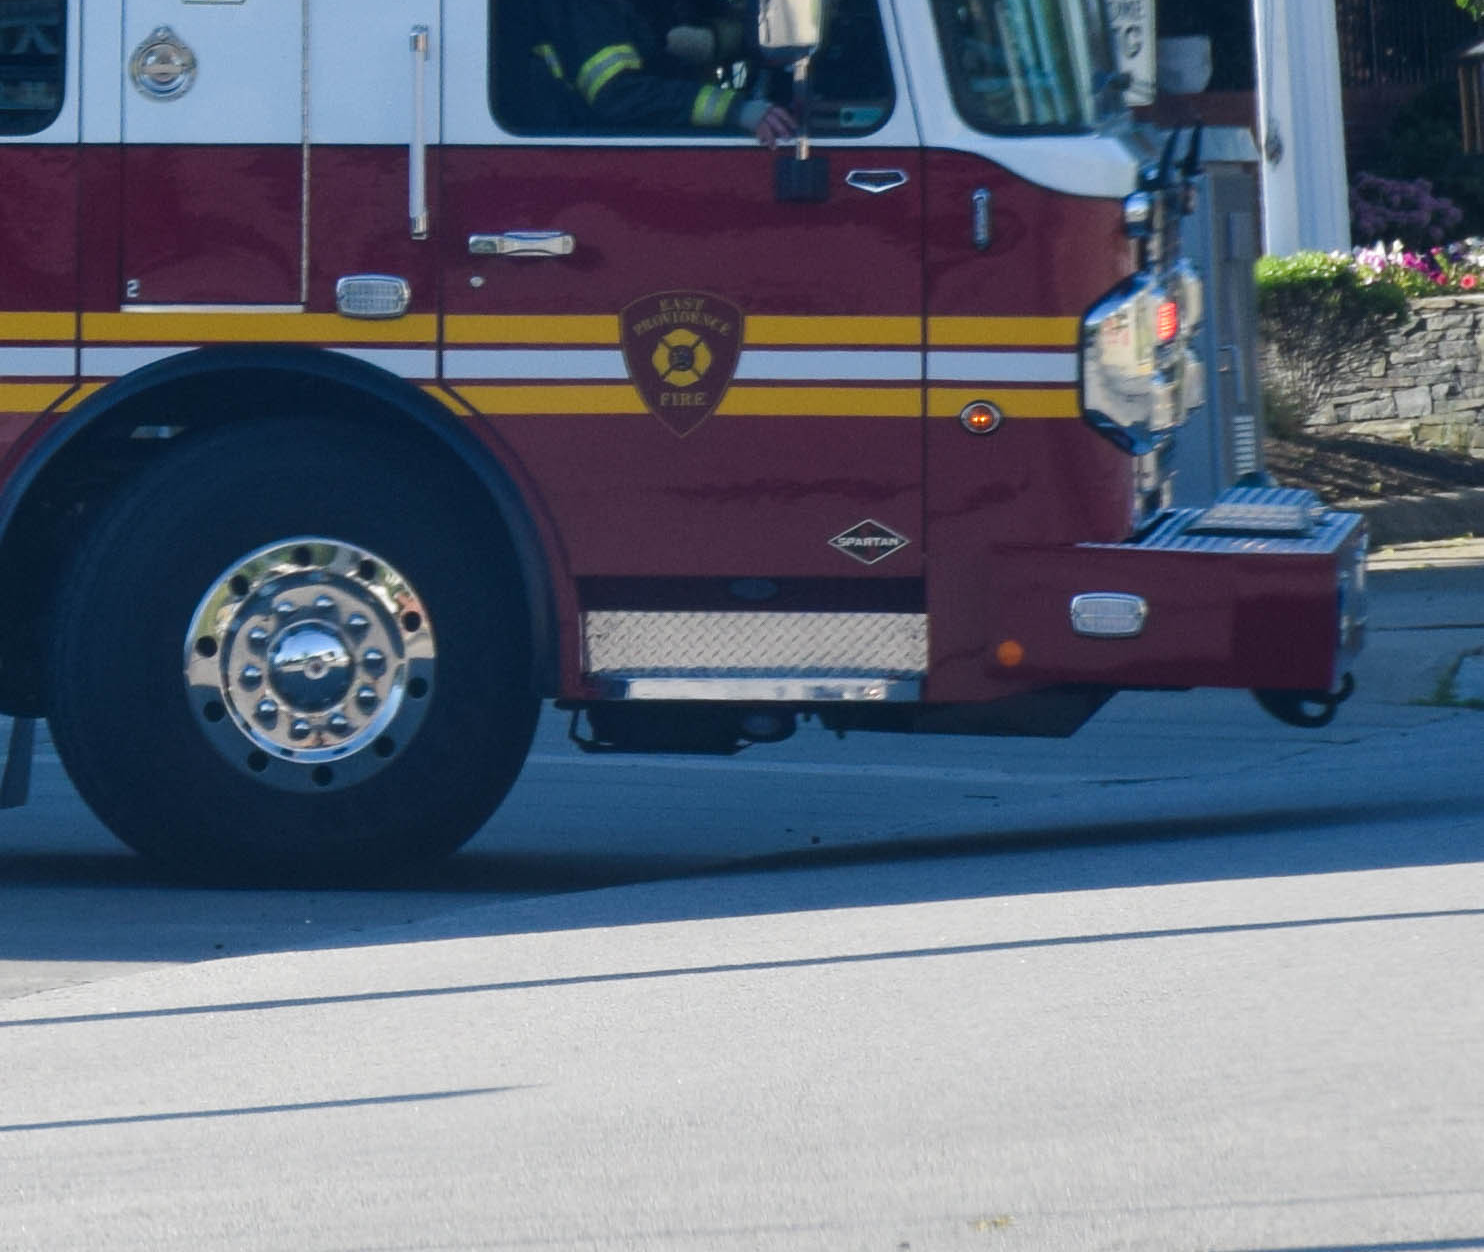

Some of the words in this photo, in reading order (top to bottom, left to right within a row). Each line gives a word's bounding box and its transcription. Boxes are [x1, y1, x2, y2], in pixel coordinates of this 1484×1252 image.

[127, 278, 140, 297] 2
[659, 299, 705, 311] EAST
[633, 311, 730, 336] PROVIDENCE
[660, 392, 705, 406] FIRE
[838, 537, 899, 547] SPARTAN
